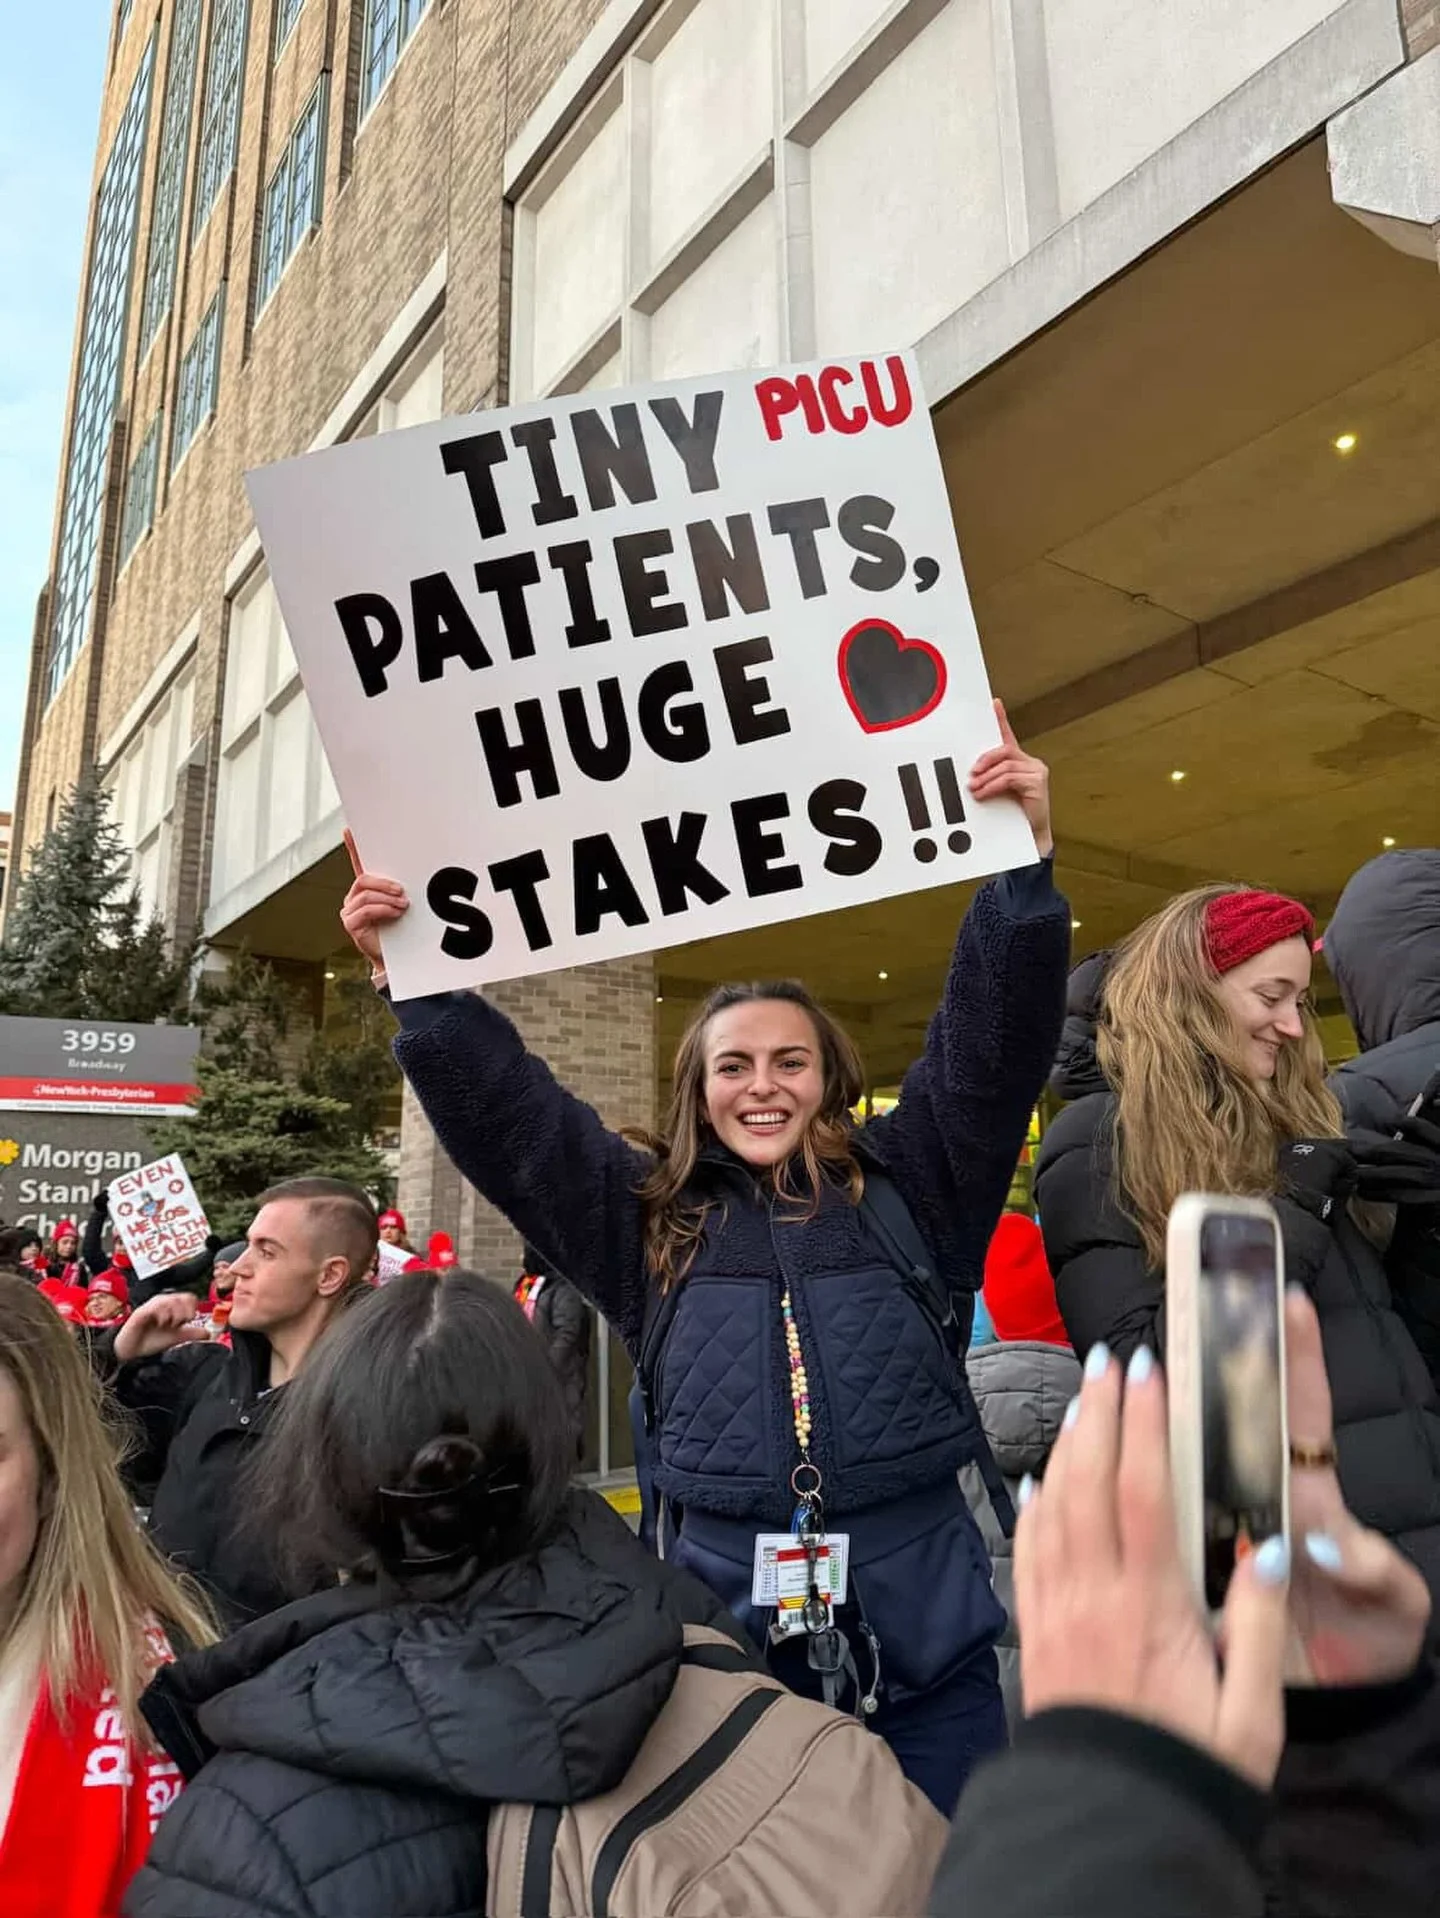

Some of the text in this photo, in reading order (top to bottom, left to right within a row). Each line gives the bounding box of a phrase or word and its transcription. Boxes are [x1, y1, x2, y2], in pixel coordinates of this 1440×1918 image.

[755, 354, 913, 442] PICU
[439, 391, 724, 540] TINY
[334, 494, 941, 699] PATIENTS,
[474, 636, 792, 808] HUGE
[427, 758, 973, 961] STAKES!!
[61, 1029, 136, 1053] 3959
[18, 1179, 101, 1203] Stanl
[21, 1143, 142, 1175] Morgan
[117, 1160, 175, 1196] EVEN
[130, 1215, 208, 1257] HEALTH
